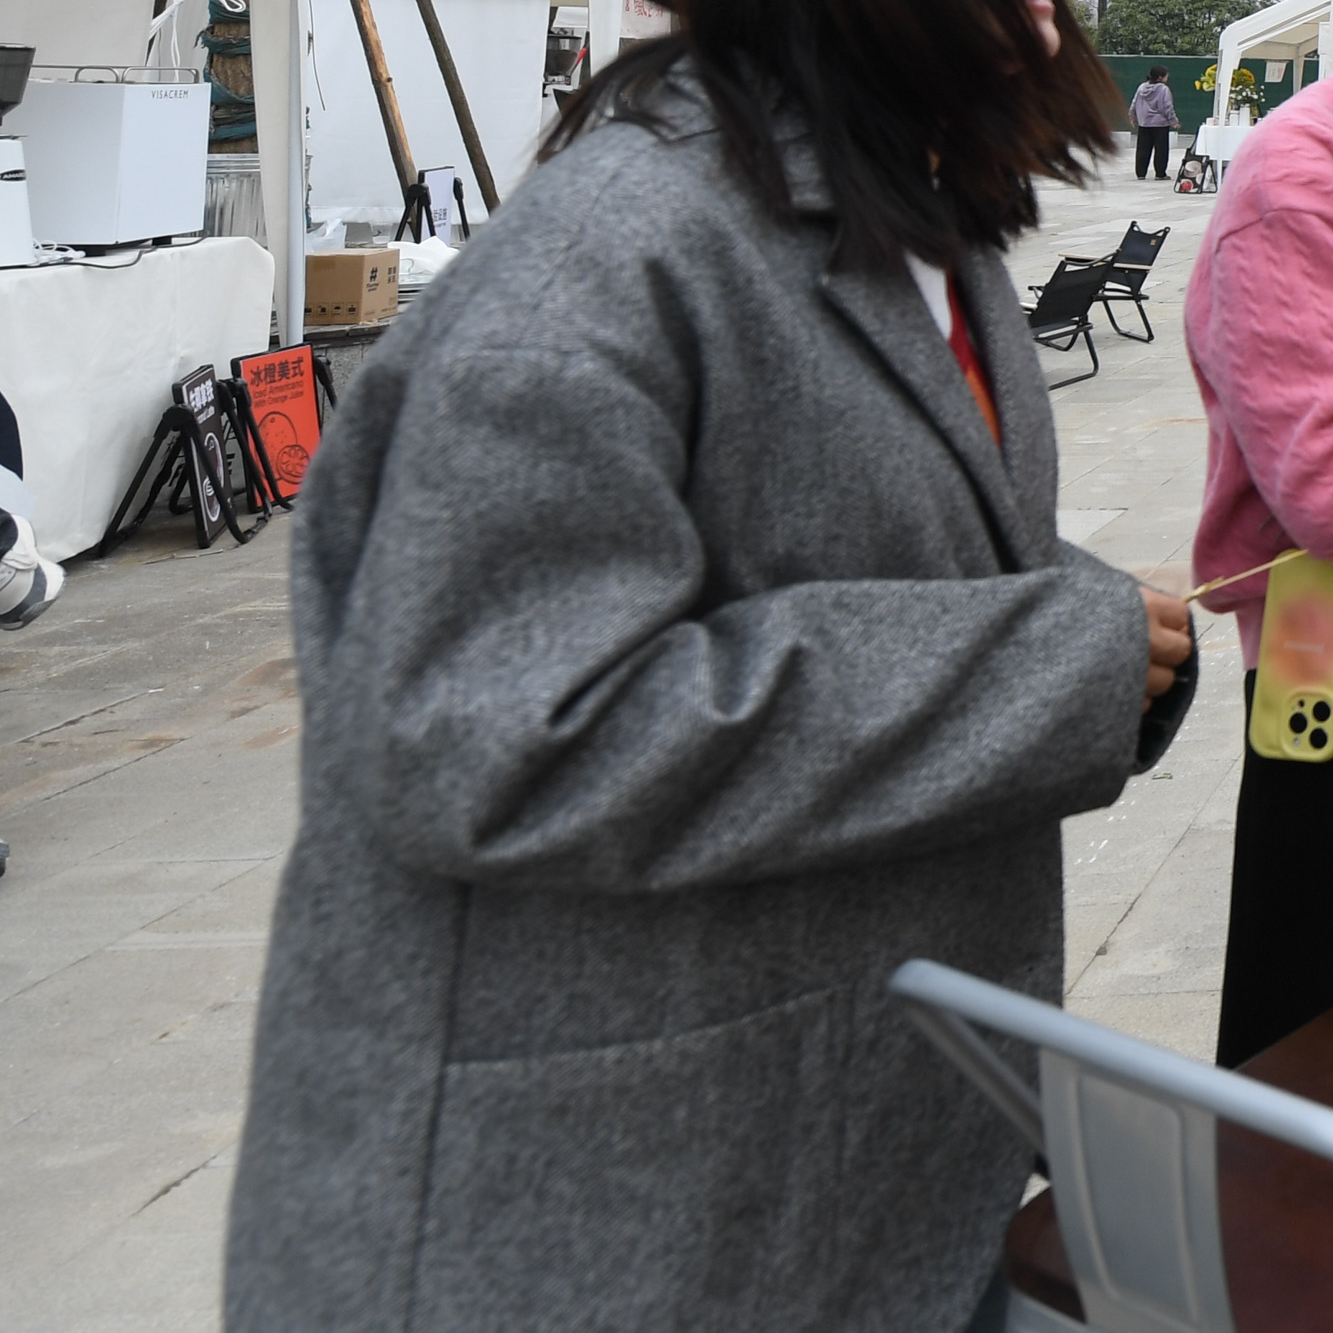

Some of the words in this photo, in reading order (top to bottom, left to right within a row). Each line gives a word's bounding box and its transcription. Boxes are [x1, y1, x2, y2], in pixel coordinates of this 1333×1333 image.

[151, 89, 189, 100] VISACREM
[250, 356, 305, 387] 冰橙美式
